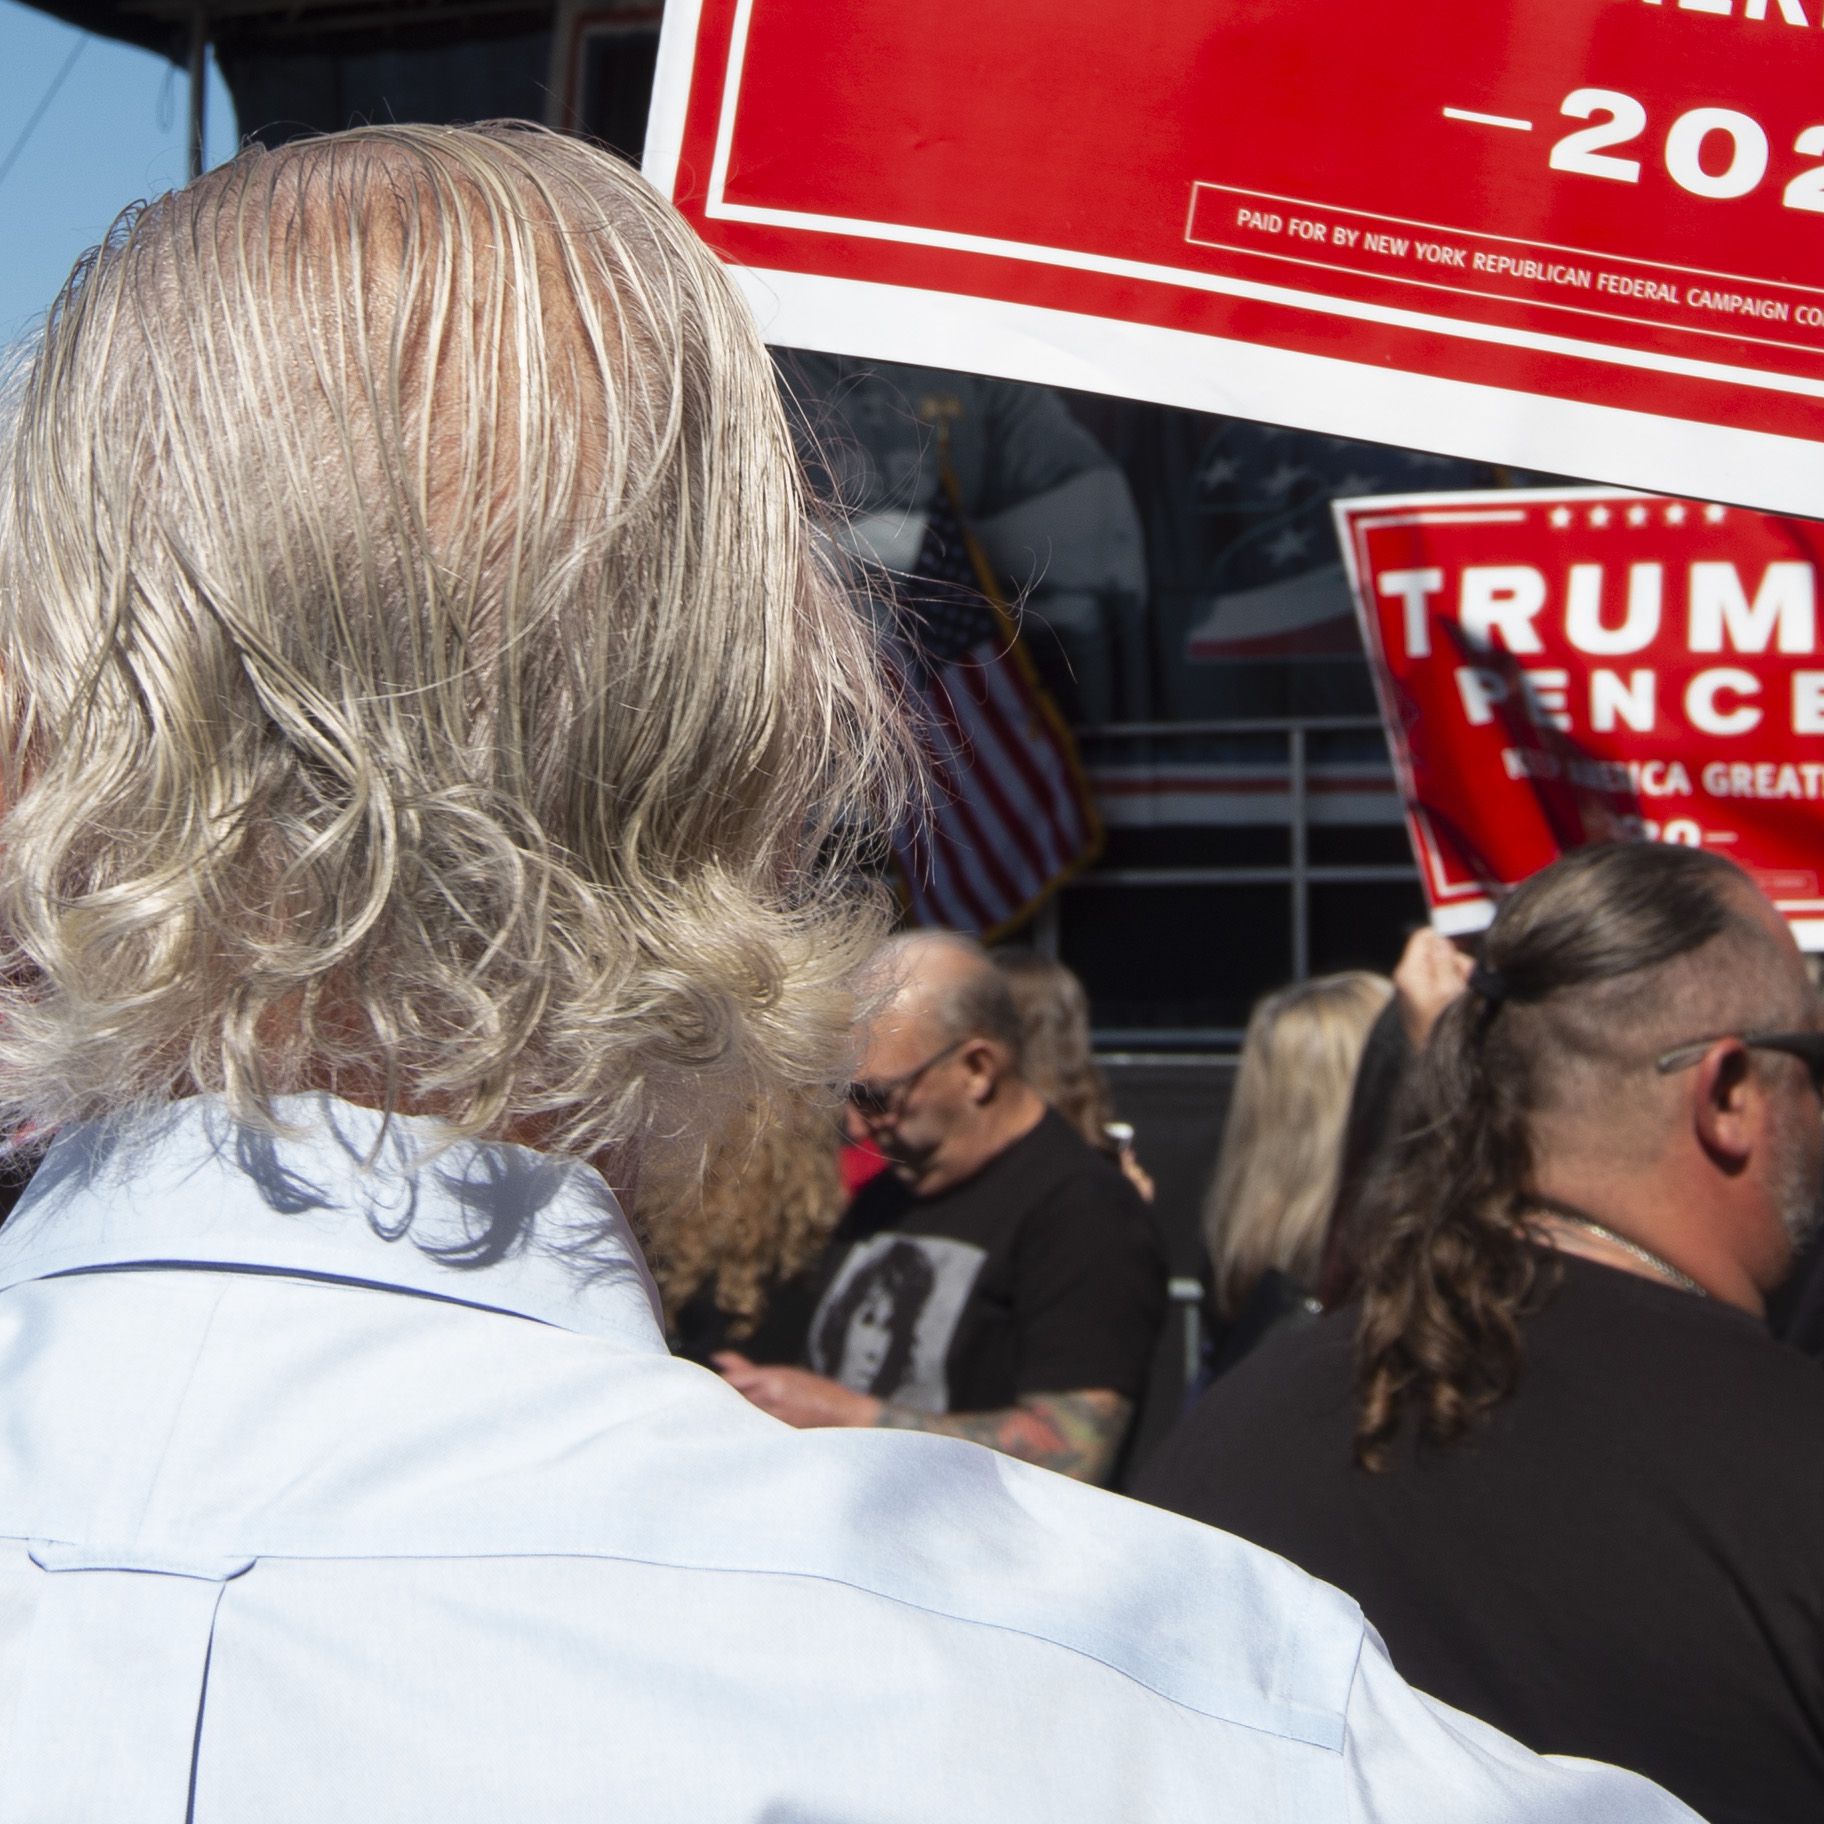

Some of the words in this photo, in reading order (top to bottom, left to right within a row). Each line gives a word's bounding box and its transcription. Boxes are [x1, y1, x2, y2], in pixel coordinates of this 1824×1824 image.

[1236, 208, 1282, 234] PAID
[1287, 217, 1327, 243] FOR
[1332, 225, 1358, 249] BY
[1363, 233, 1409, 258] NEW
[1414, 241, 1468, 268] YORK
[1472, 252, 1592, 289] REPUBLICAN
[1595, 272, 1680, 305] FEDERAL
[1686, 287, 1790, 322] CAMPAIGN
